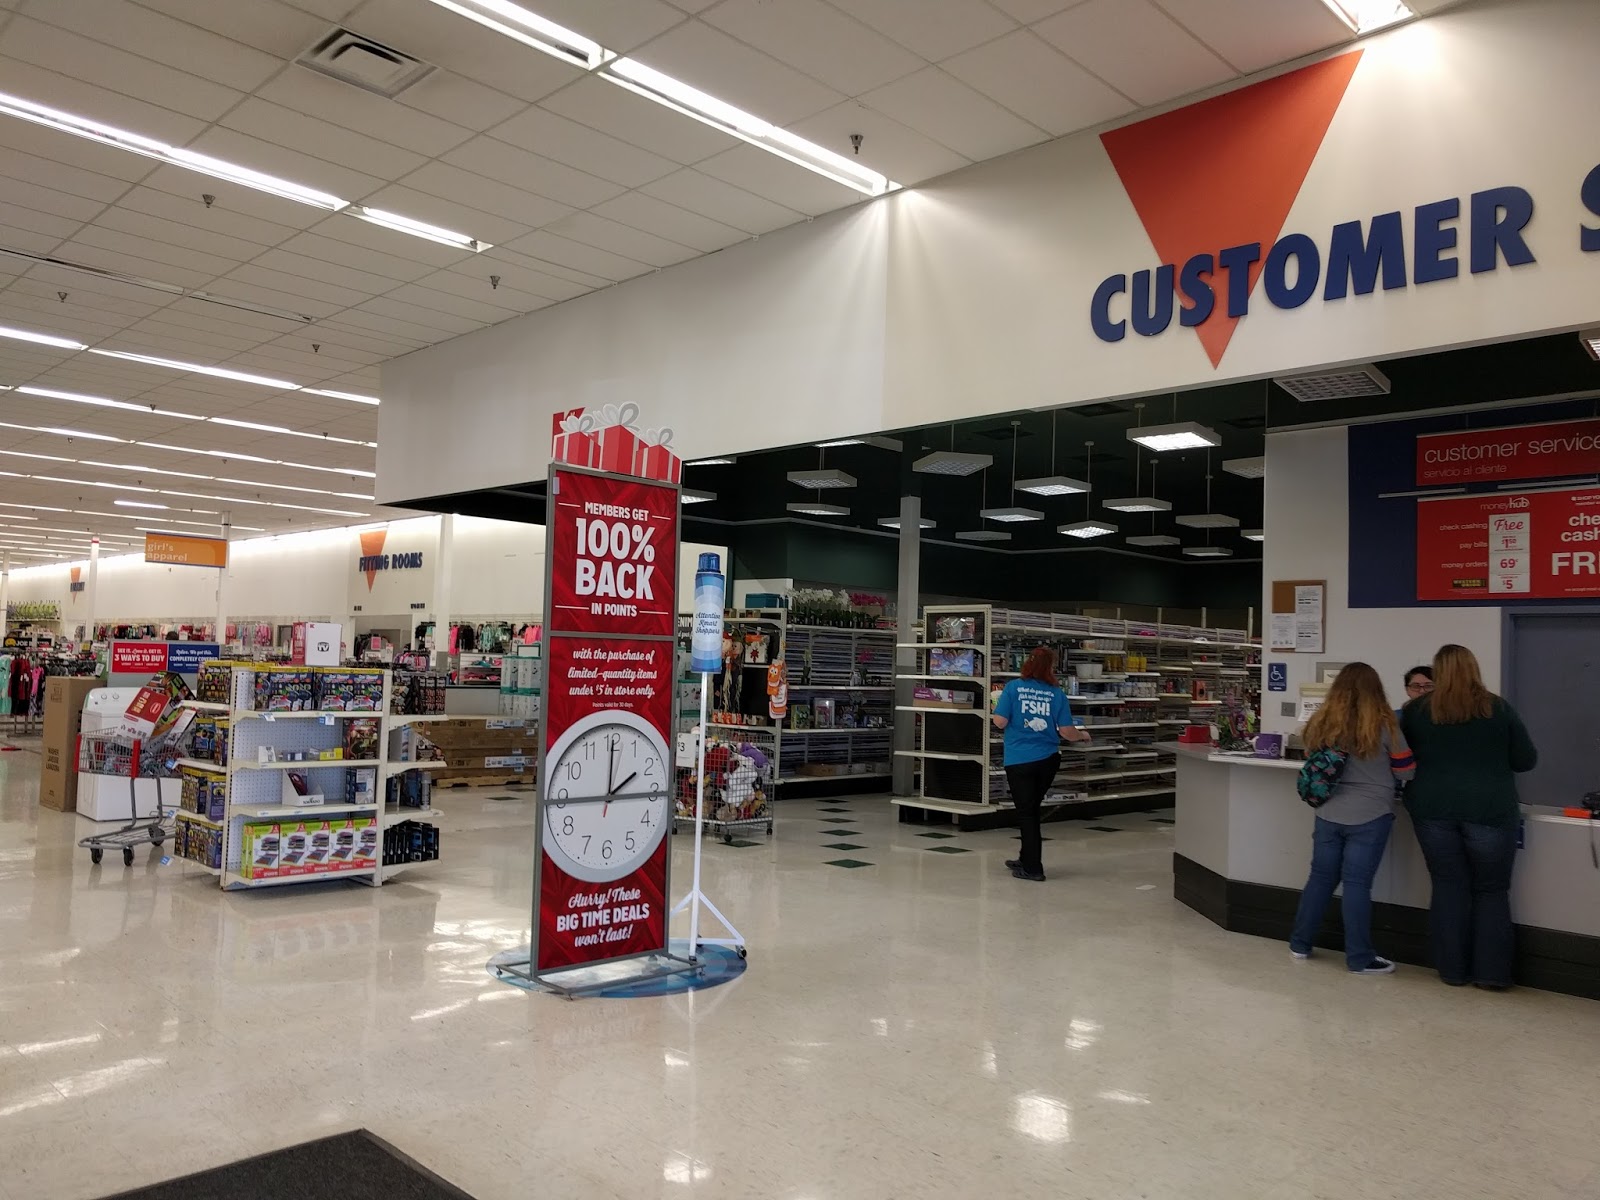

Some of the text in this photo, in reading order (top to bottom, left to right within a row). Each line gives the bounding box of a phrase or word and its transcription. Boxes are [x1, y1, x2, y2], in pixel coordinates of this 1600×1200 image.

[1090, 185, 1537, 343] CUSTOMER
[1424, 432, 1600, 464] customer service
[1424, 464, 1508, 479] servicio al cliente
[585, 501, 649, 521] MEMBERS GET
[1480, 496, 1530, 511] moneyhub
[1461, 522, 1488, 531] cashing
[1494, 518, 1524, 532] Free
[1568, 512, 1600, 527] che
[576, 517, 655, 563] 100%
[1561, 527, 1600, 542] cash
[147, 543, 174, 552] girl's
[147, 553, 188, 562] apparel
[359, 552, 423, 572] FITTING ROOMS
[1551, 551, 1600, 576] FR
[575, 558, 655, 600] BACK
[591, 603, 637, 617] IN POINTS
[695, 627, 720, 635] Shoppers
[120, 654, 140, 662] WAYS
[142, 654, 150, 662] TO
[573, 648, 656, 665] with the purchase of
[636, 668, 657, 679] items
[569, 684, 655, 699] under $5 in store only.
[1021, 700, 1050, 717] FSH!
[582, 741, 595, 760] 11
[603, 732, 621, 752] 12
[631, 739, 637, 758] 1
[677, 742, 685, 752] $3
[564, 761, 582, 780] 10
[644, 757, 654, 776] 2
[556, 788, 568, 809] 9
[648, 782, 659, 802] 3
[562, 815, 574, 835] 8
[640, 809, 650, 827] 4
[582, 835, 592, 855] 7
[602, 840, 612, 859] 6
[625, 831, 635, 850] 5
[568, 887, 641, 909] Hurry! These
[556, 903, 650, 932] BIG TIME DEALS
[575, 923, 633, 947] won't last!
